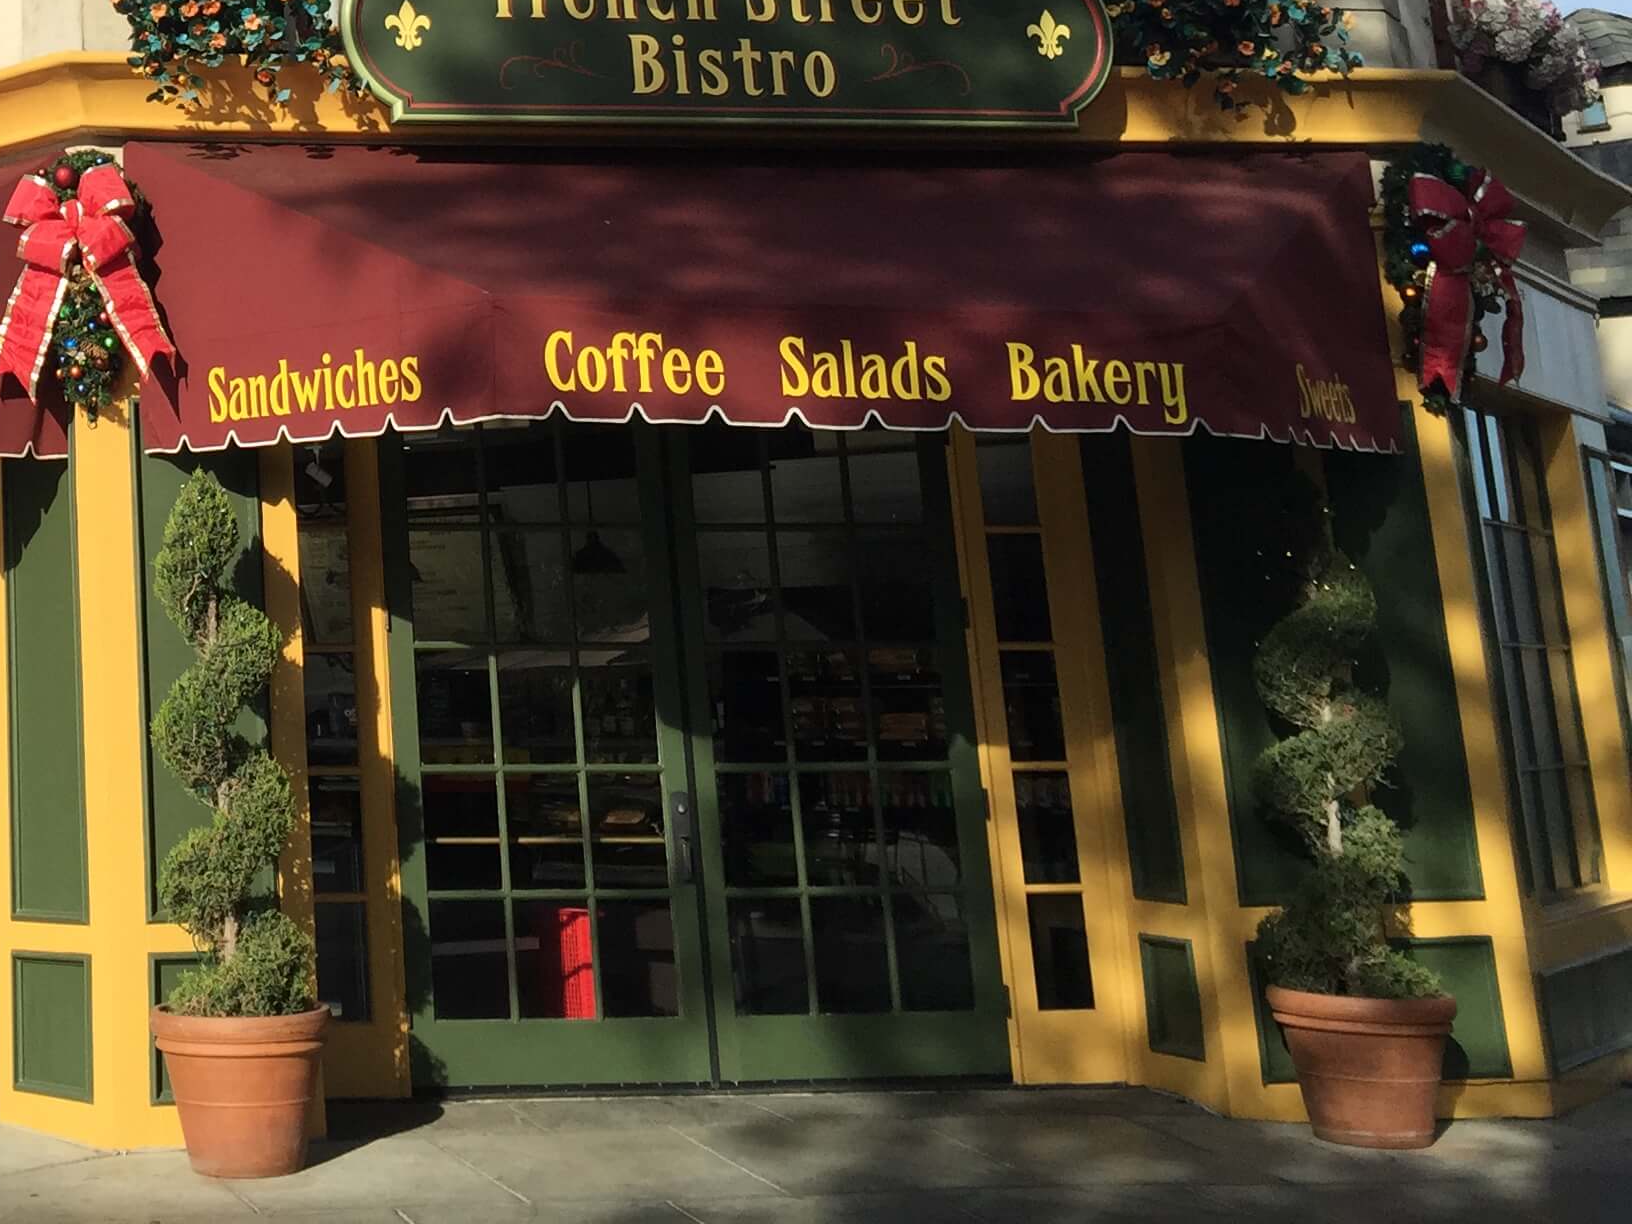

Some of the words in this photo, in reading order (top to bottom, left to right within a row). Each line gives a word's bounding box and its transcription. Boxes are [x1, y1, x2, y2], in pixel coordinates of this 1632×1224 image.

[628, 34, 836, 98] Bistro
[208, 349, 422, 424] Sandwiches
[544, 330, 725, 396] Coffee
[779, 336, 952, 401] Salads
[1005, 342, 1188, 424] Bakery
[1295, 363, 1358, 425] Sweets
